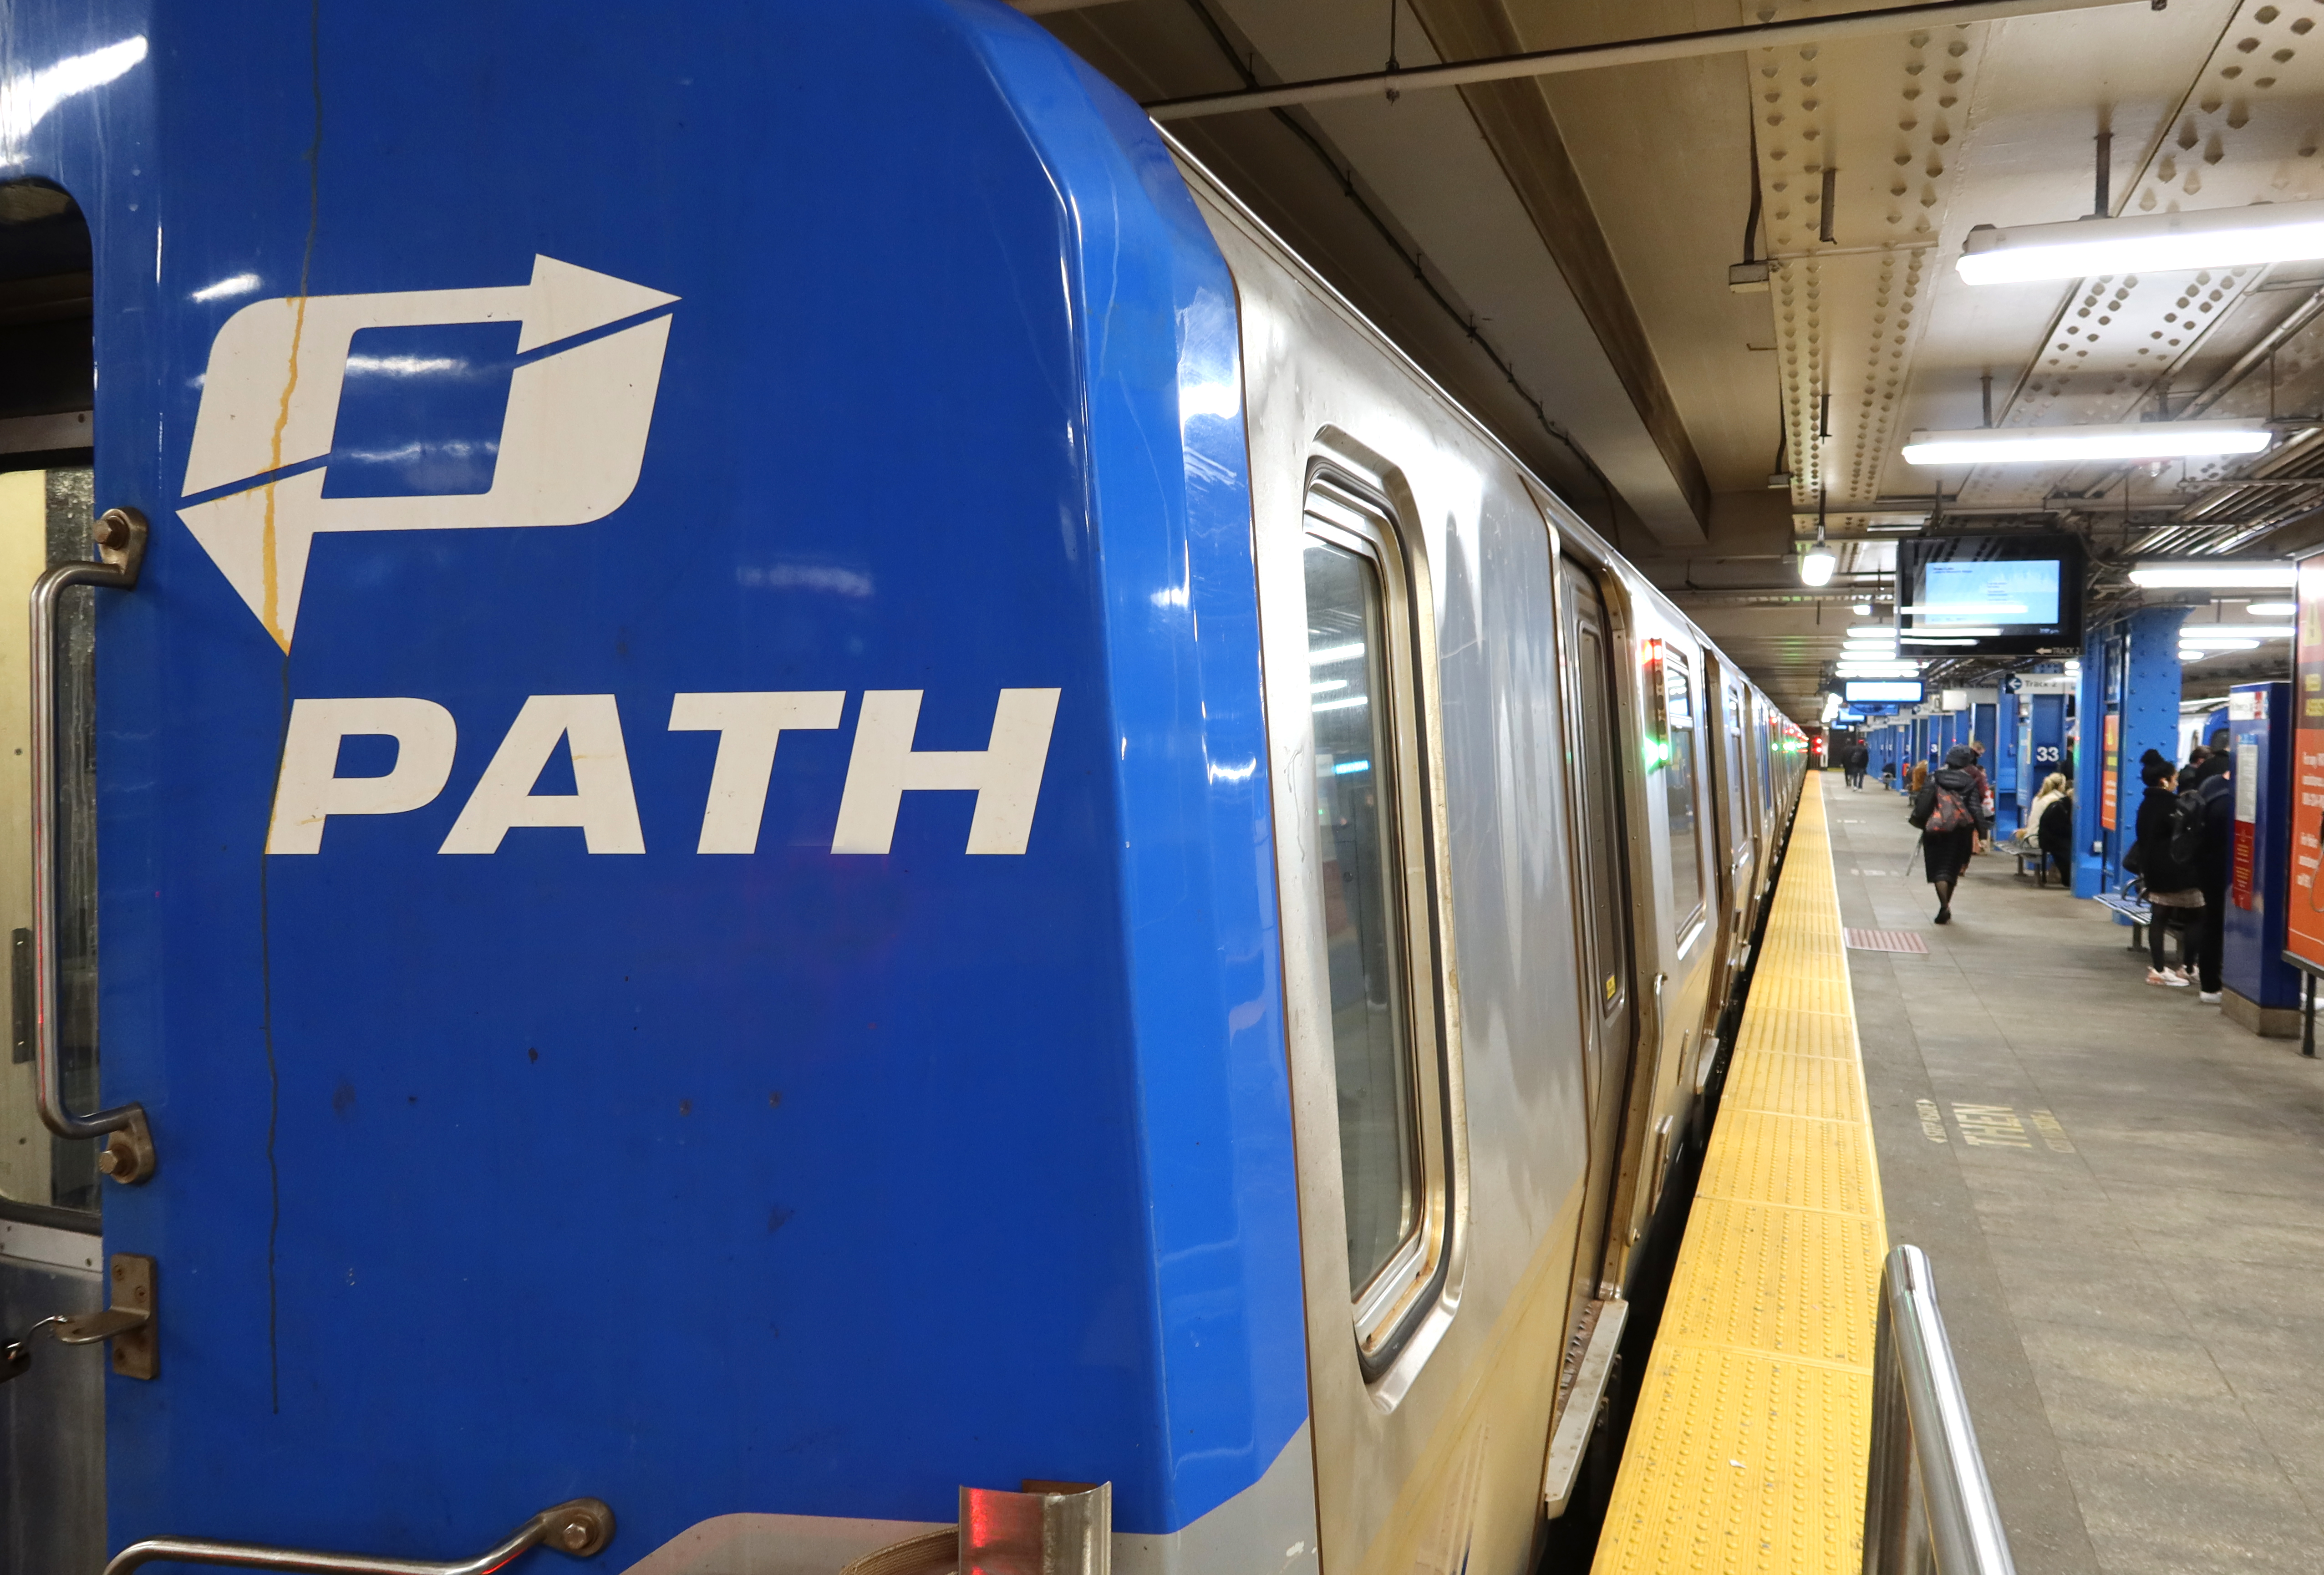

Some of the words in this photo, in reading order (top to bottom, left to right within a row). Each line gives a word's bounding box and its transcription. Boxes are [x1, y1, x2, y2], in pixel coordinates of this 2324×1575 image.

[264, 687, 1062, 854] PATH
[2036, 747, 2059, 762] 33
[1951, 1102, 2033, 1148] THEN
